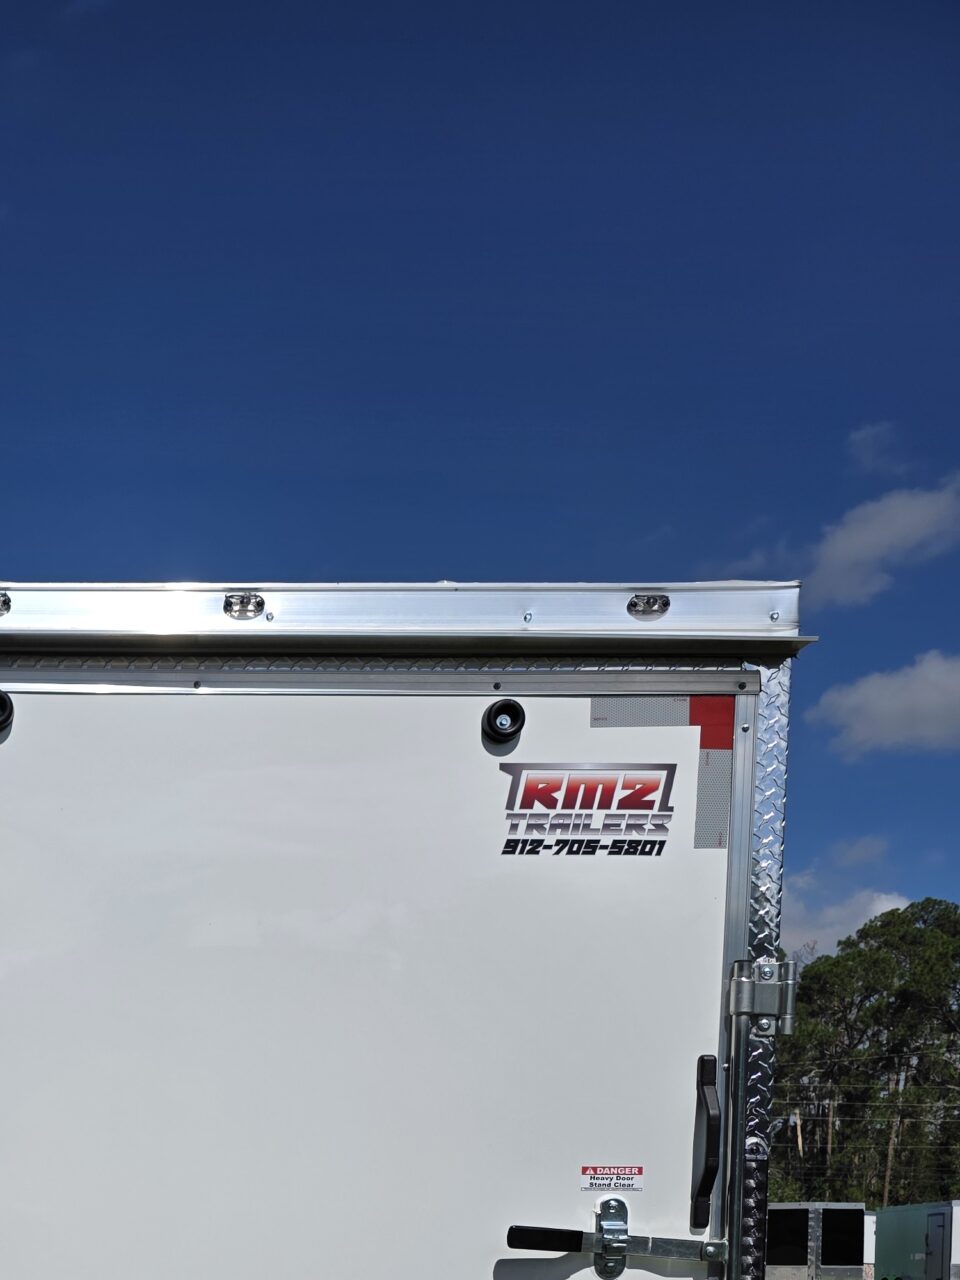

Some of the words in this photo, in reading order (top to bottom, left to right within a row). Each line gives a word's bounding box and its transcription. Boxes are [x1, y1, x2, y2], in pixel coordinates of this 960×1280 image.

[519, 773, 662, 811] RMZ
[505, 813, 672, 836] TRAILERS
[501, 838, 667, 857] 912-705-5801
[596, 1167, 639, 1175] DANGER
